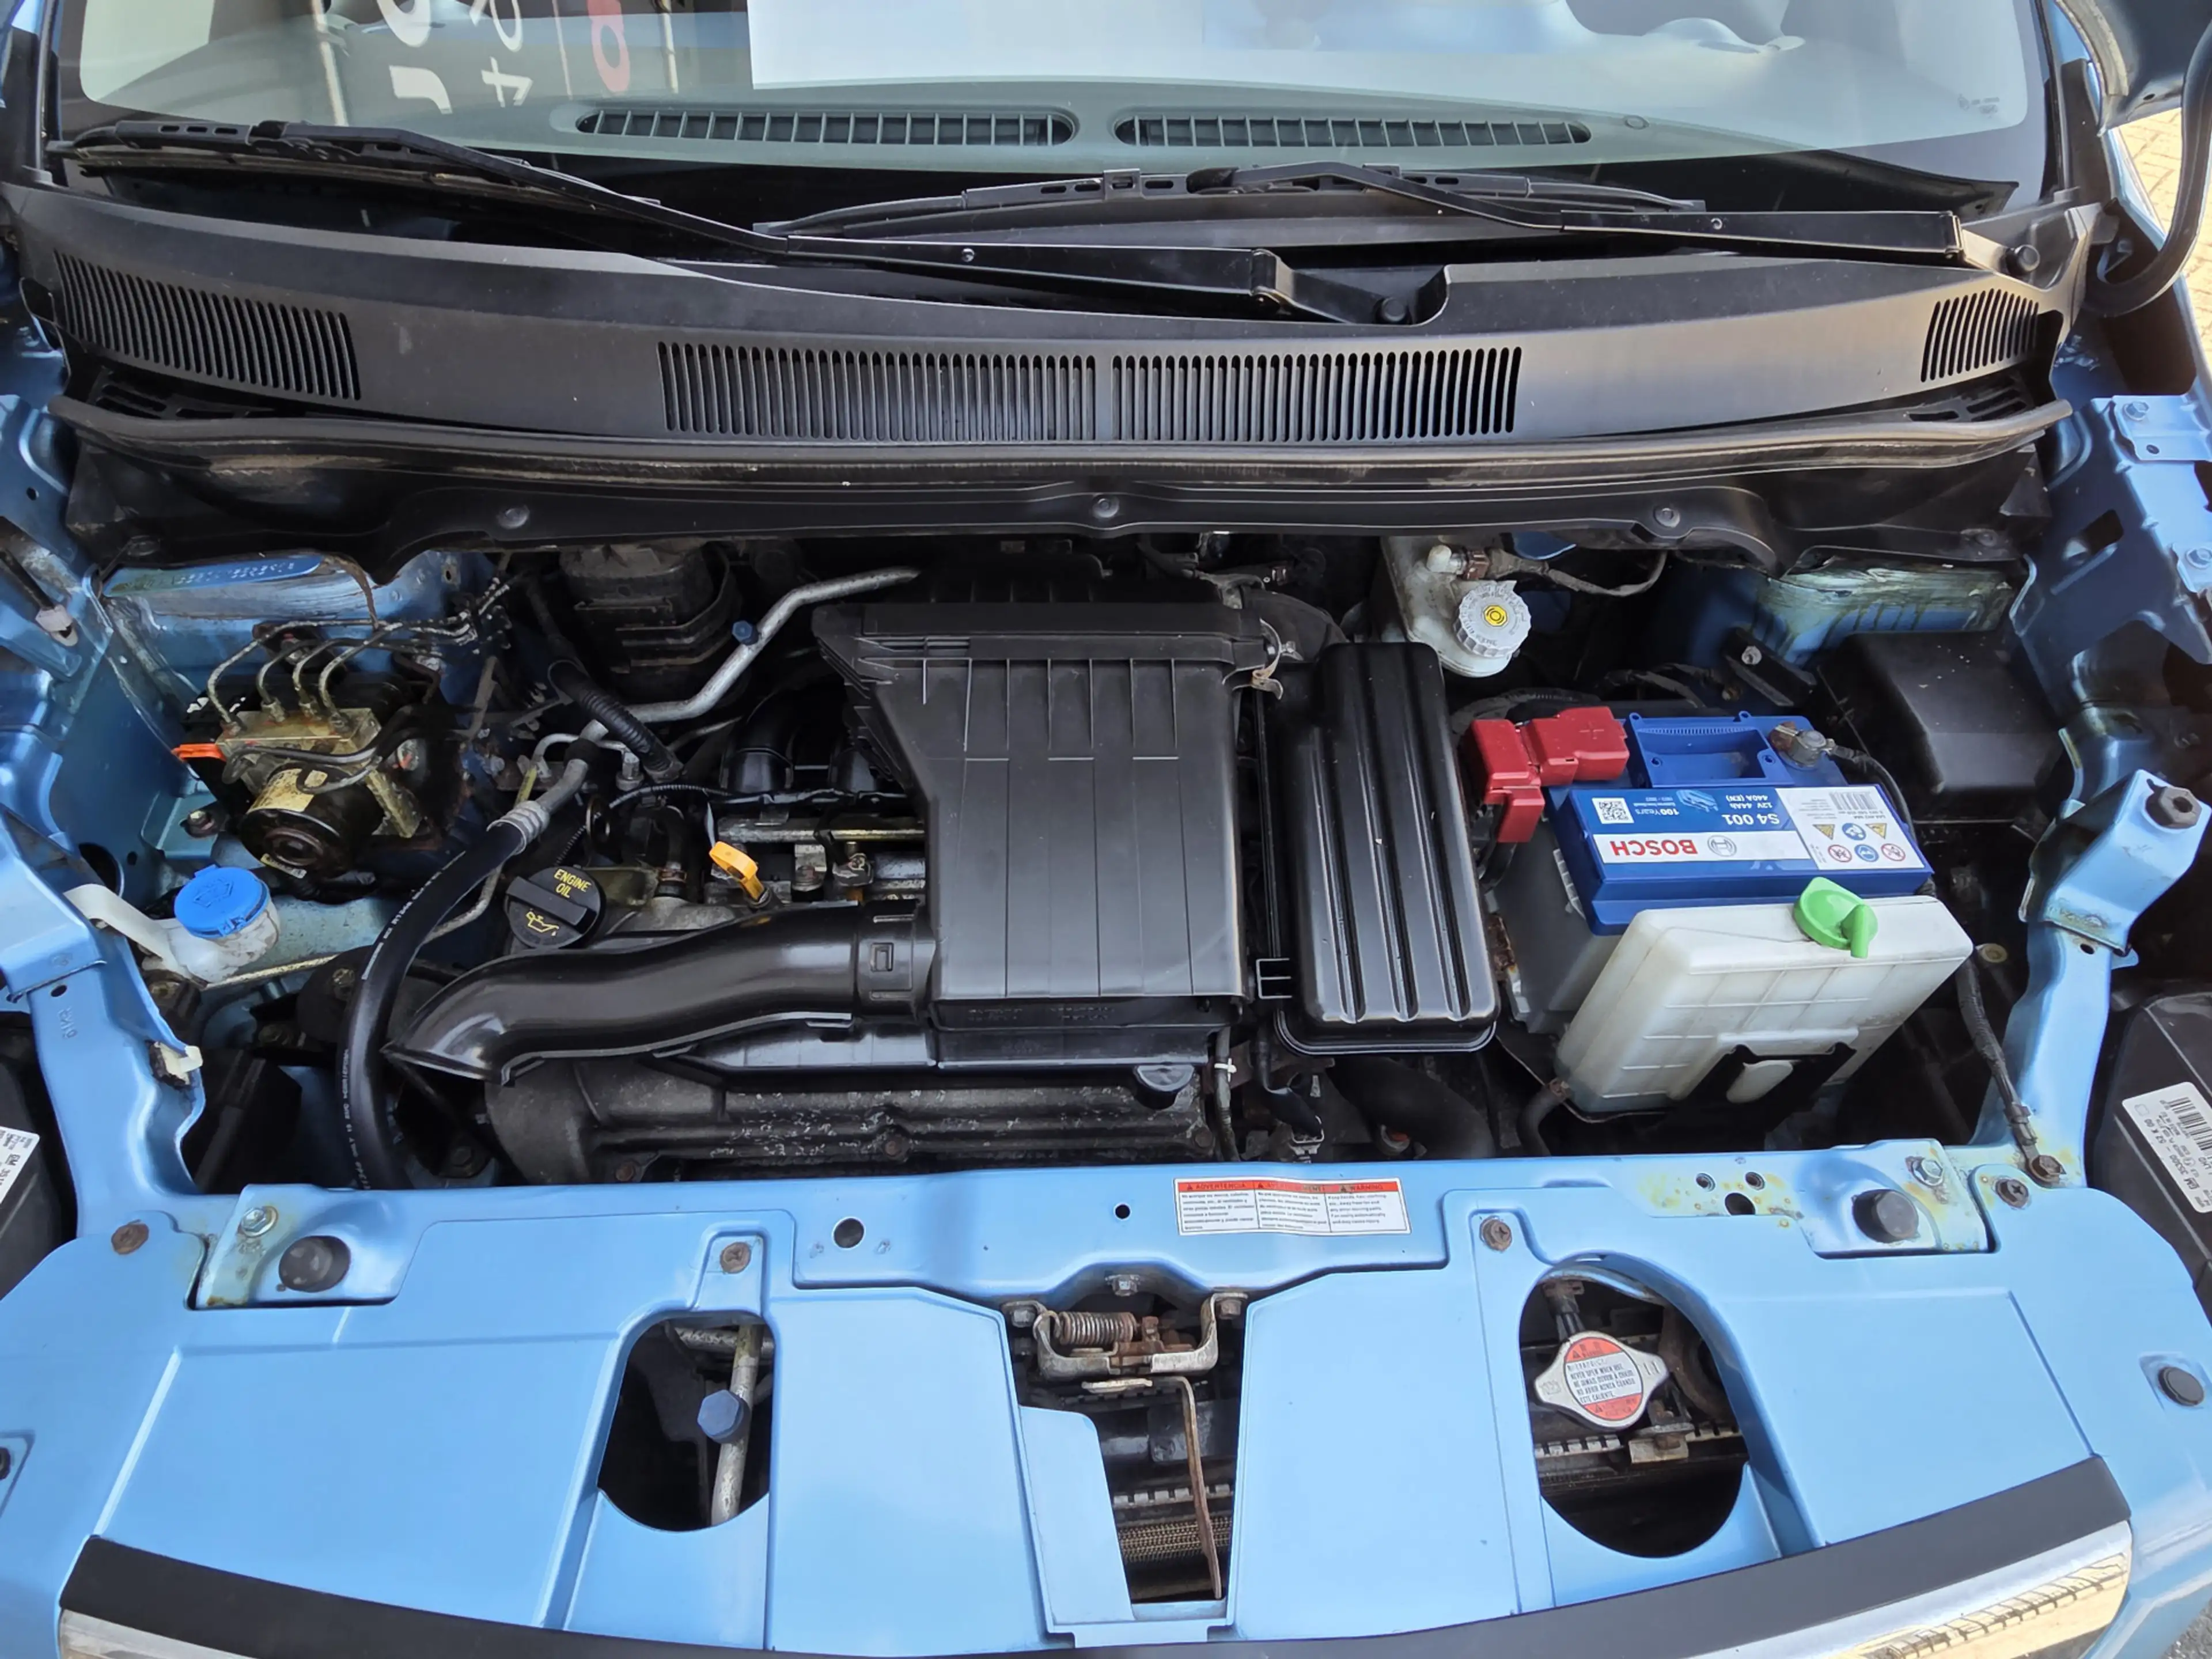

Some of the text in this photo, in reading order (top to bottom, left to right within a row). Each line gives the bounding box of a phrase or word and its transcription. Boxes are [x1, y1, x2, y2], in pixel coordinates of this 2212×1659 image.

[1721, 813, 1780, 825] S4 001
[1609, 839, 1698, 856] BOSCH
[554, 869, 592, 892] ENGINE
[555, 883, 571, 898] OIL
[2184, 1177, 2200, 1190] GM
